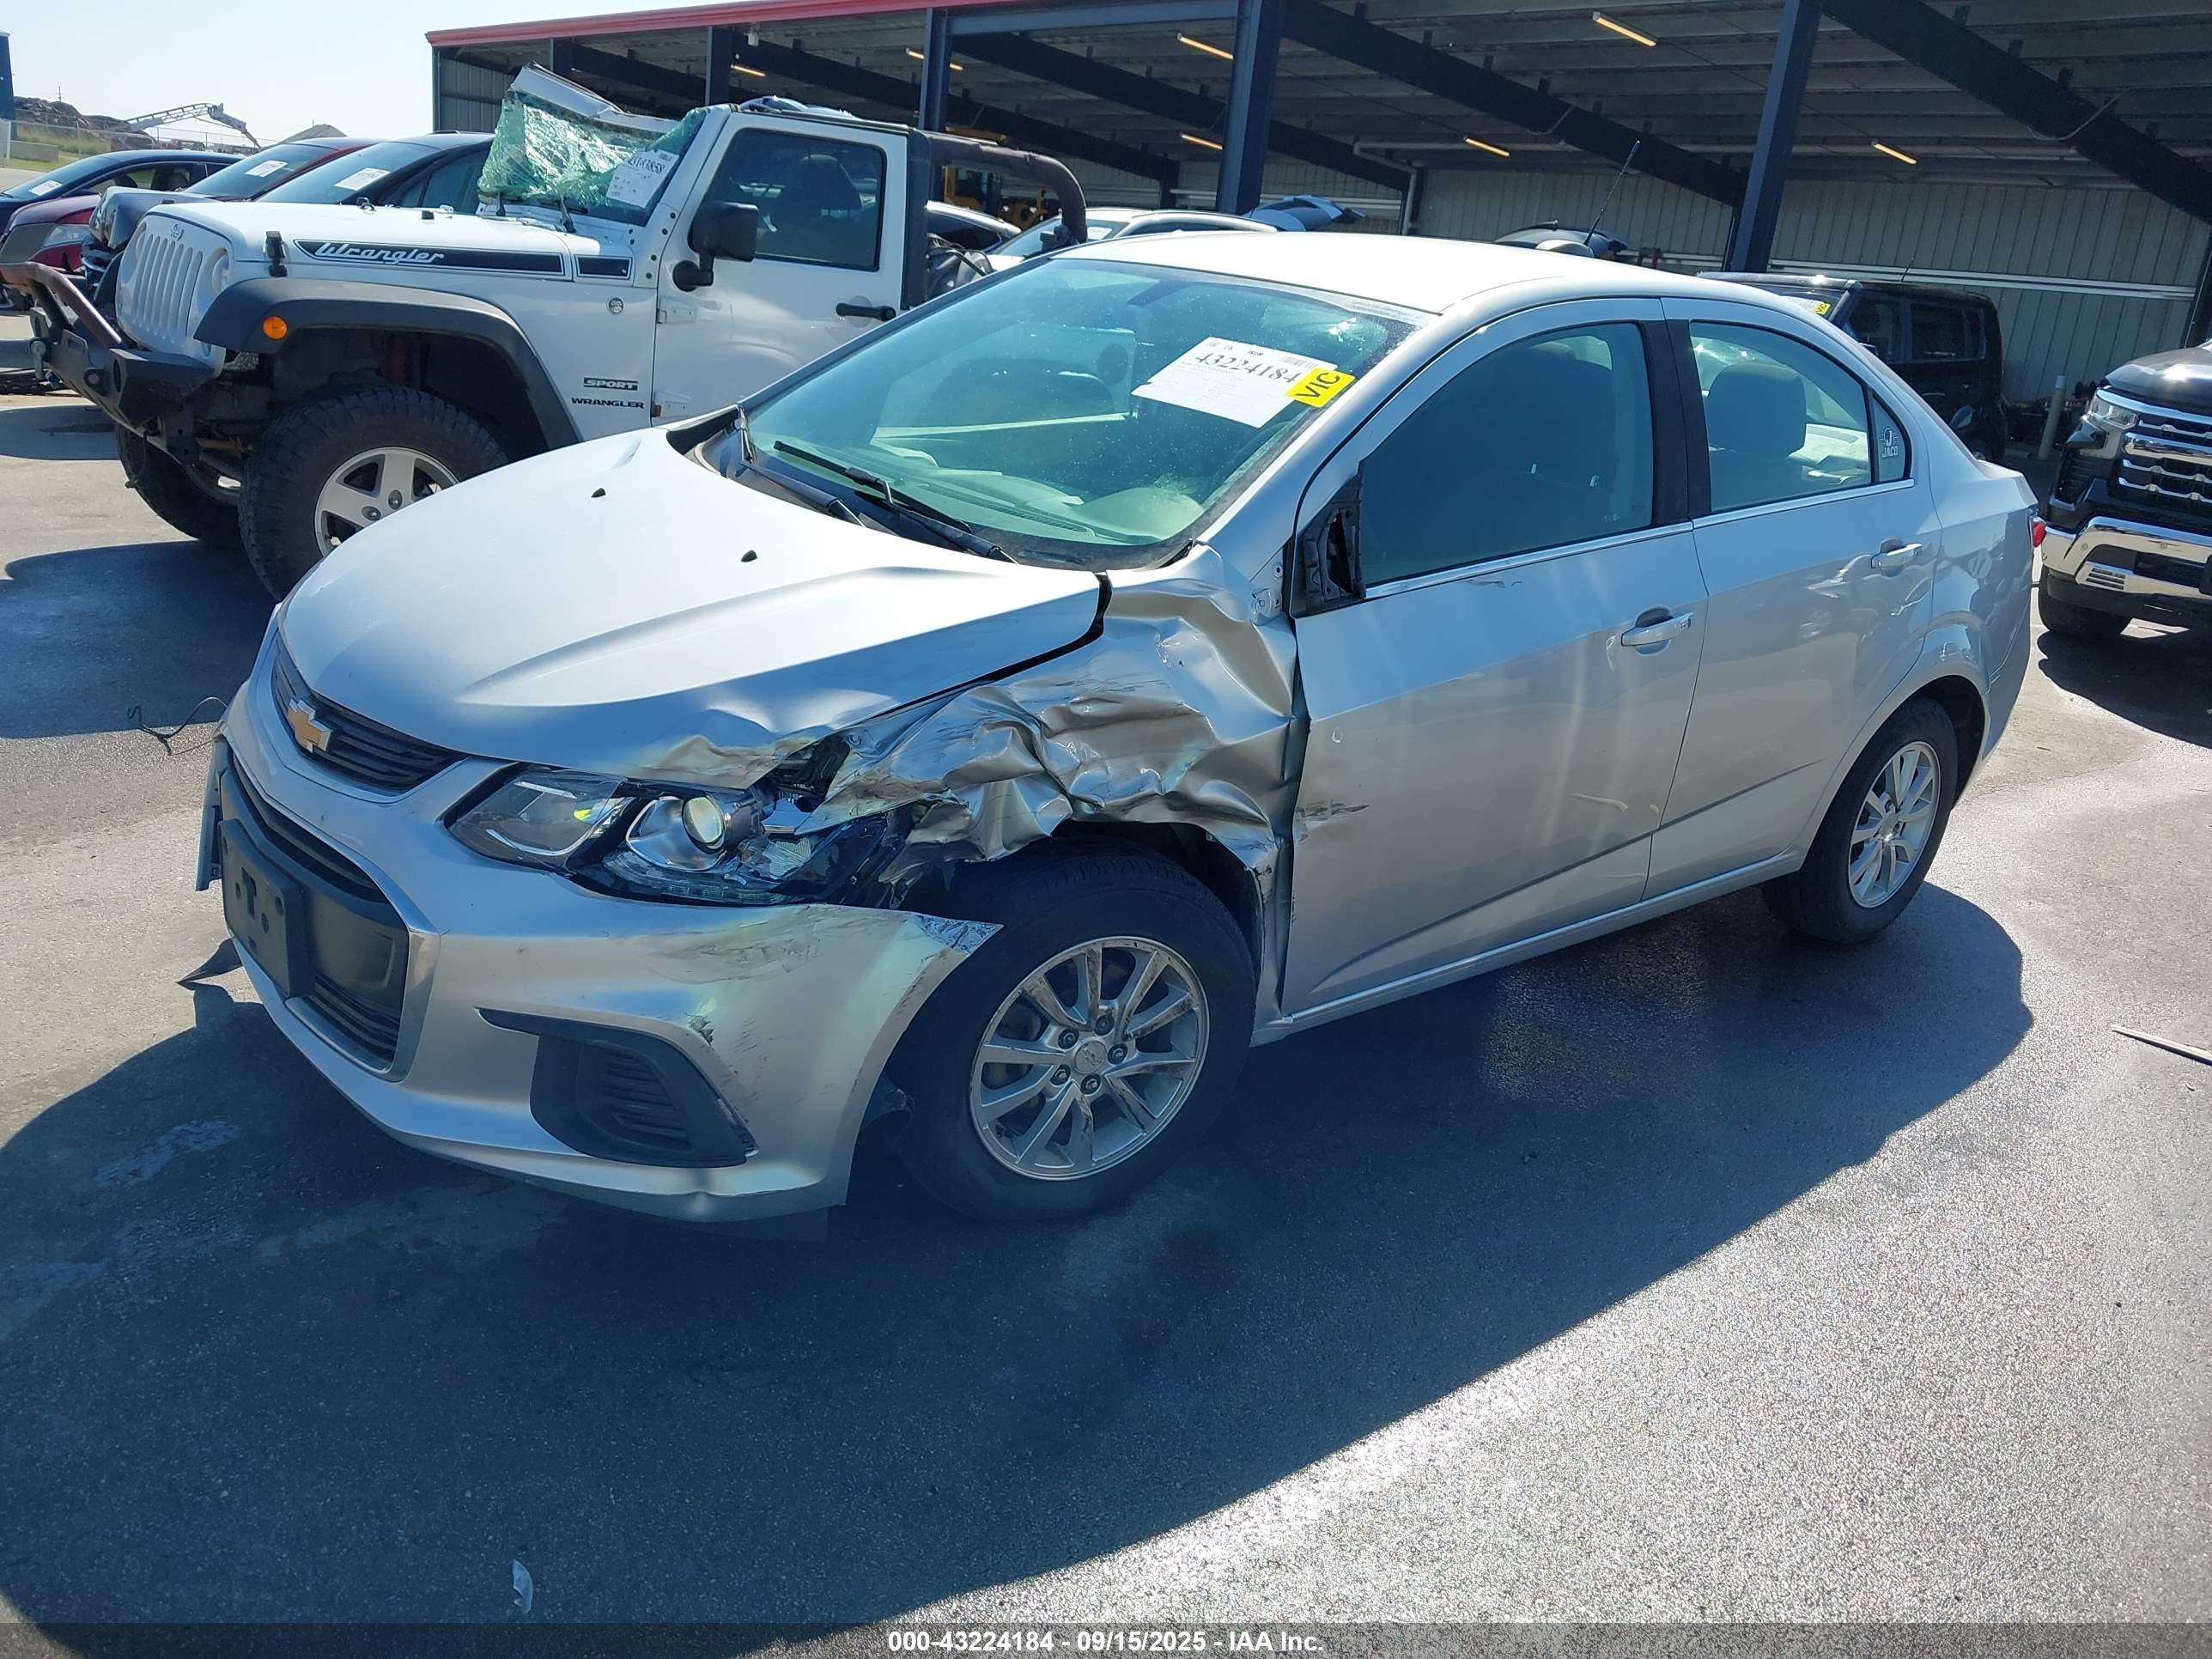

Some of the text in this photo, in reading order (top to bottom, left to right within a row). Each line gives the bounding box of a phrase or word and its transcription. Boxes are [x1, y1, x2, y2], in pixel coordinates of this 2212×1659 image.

[314, 242, 445, 265] Wrangler
[1194, 351, 1303, 384] 43224184
[585, 379, 638, 391] SPORT
[1295, 372, 1341, 399] VIC
[571, 398, 645, 409] WRANGLER
